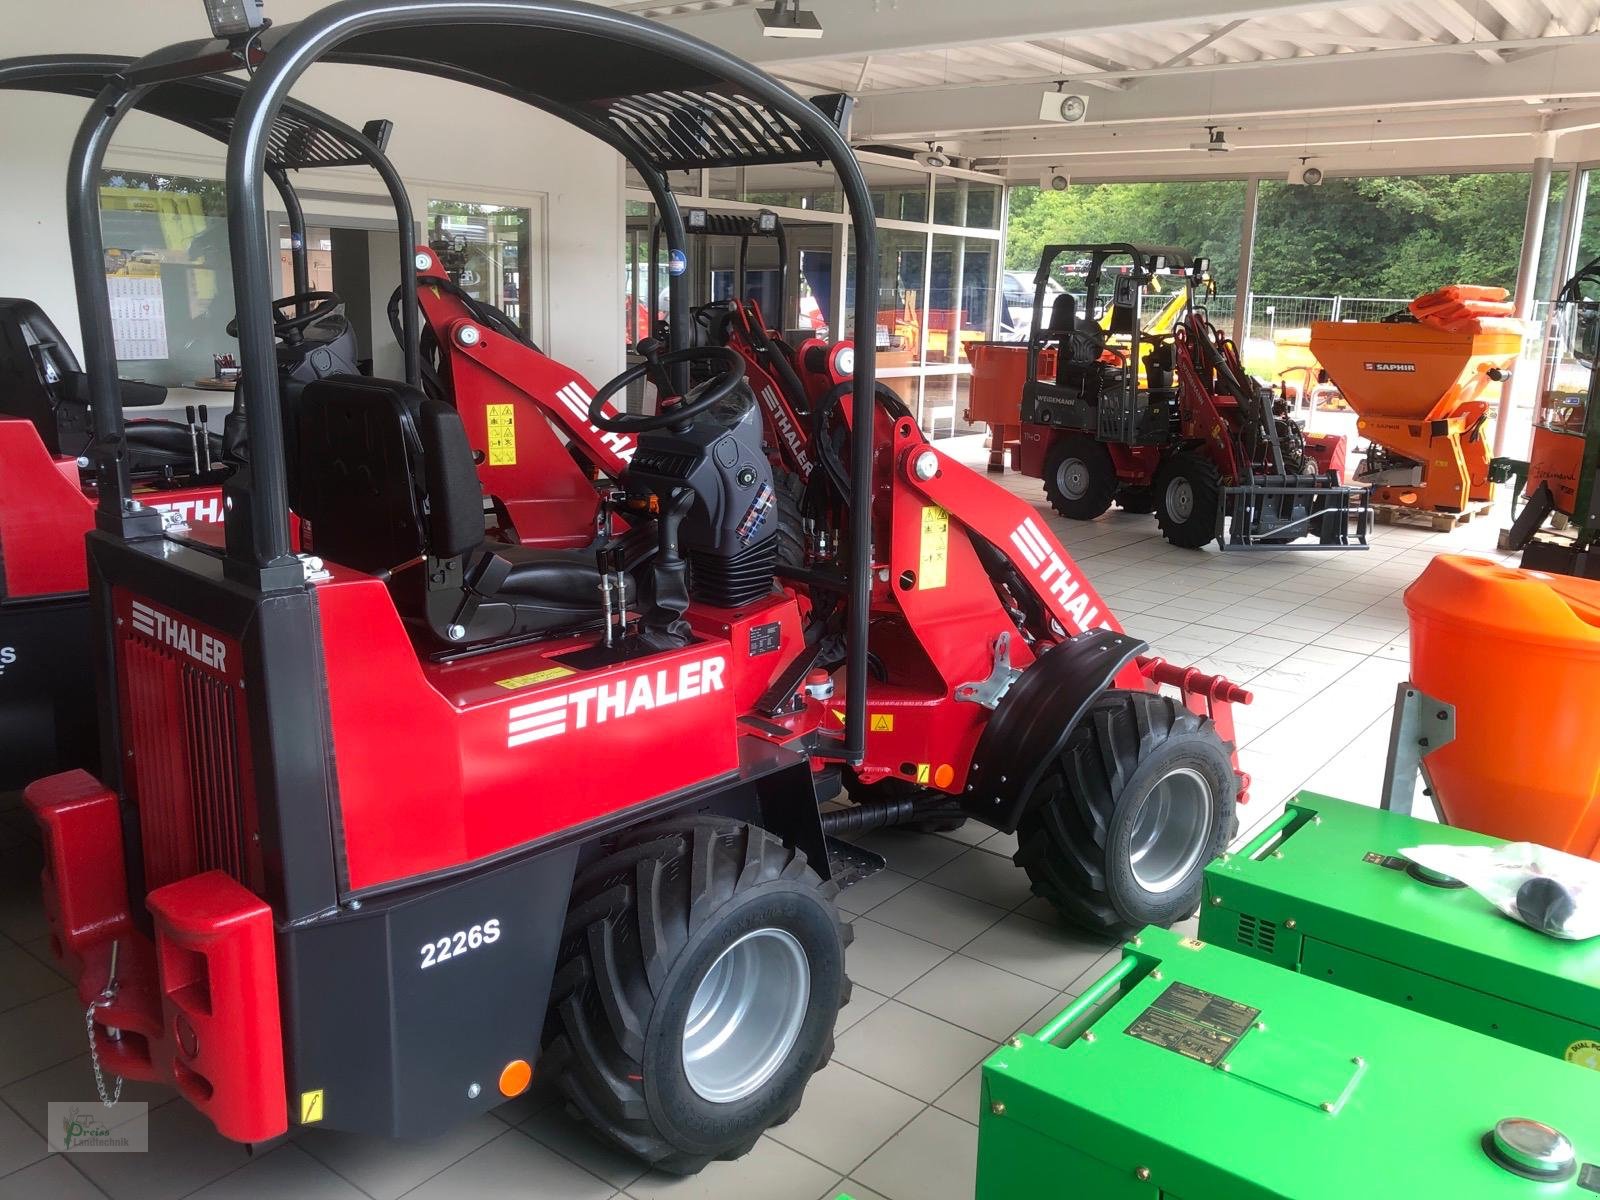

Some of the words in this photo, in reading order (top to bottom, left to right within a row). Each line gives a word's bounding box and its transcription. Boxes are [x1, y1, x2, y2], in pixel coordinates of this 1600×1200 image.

[1376, 363, 1415, 372] SAPHIR
[1037, 395, 1075, 406] WEIDEMANN
[774, 405, 814, 477] THALER
[1024, 432, 1041, 442] 1140
[1040, 551, 1112, 632] THAL
[154, 610, 226, 673] THALER
[568, 656, 726, 729] THALER
[420, 918, 501, 970] 2226S
